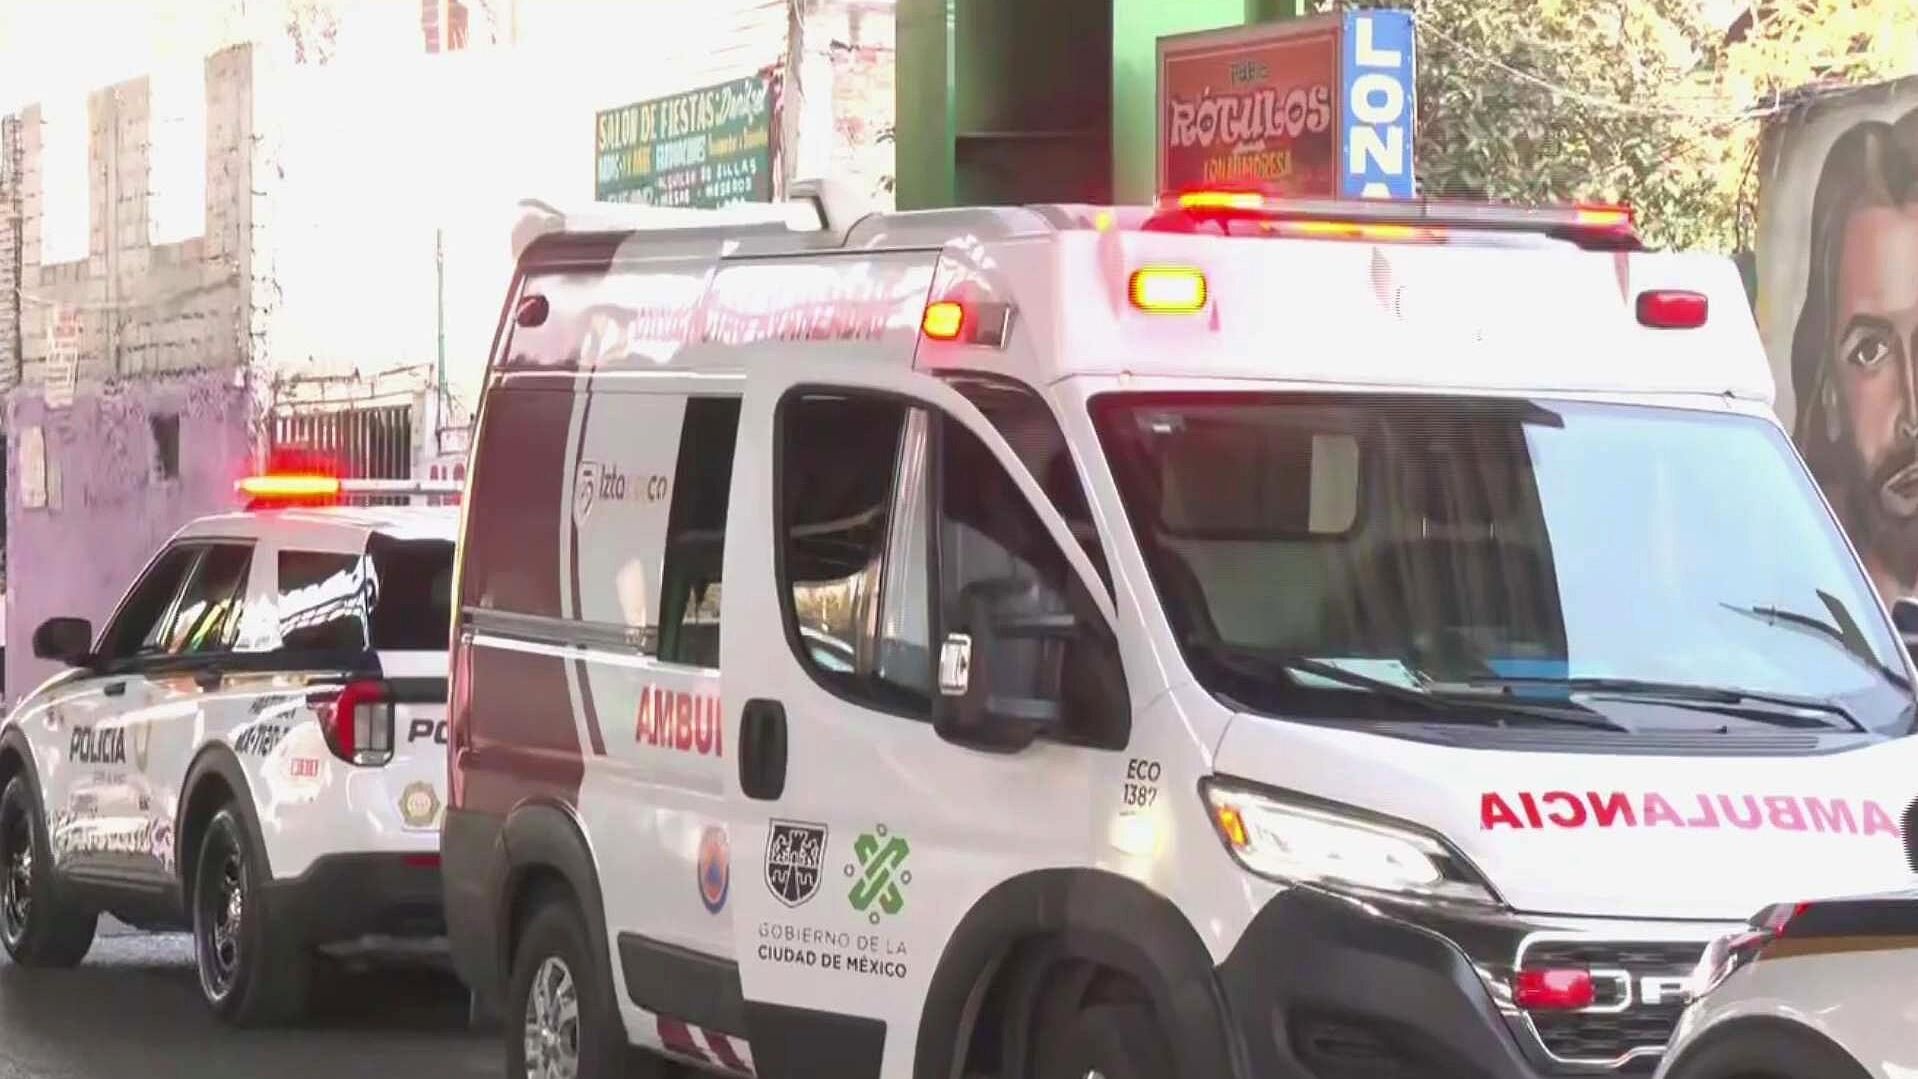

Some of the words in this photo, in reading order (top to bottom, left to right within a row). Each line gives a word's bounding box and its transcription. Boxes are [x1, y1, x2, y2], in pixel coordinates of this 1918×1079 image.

[641, 103, 657, 144] DE
[660, 91, 714, 140] FIESTAS
[1170, 86, 1331, 147] RÓTULOS
[69, 725, 126, 764] POLICIA
[1127, 758, 1161, 782] ECO
[758, 922, 850, 948] GOBIERNO
[857, 935, 879, 953] DE
[886, 939, 908, 956] LA
[757, 944, 817, 967] CIUDAD
[821, 953, 842, 970] DE
[846, 954, 908, 979] MÉXICO
